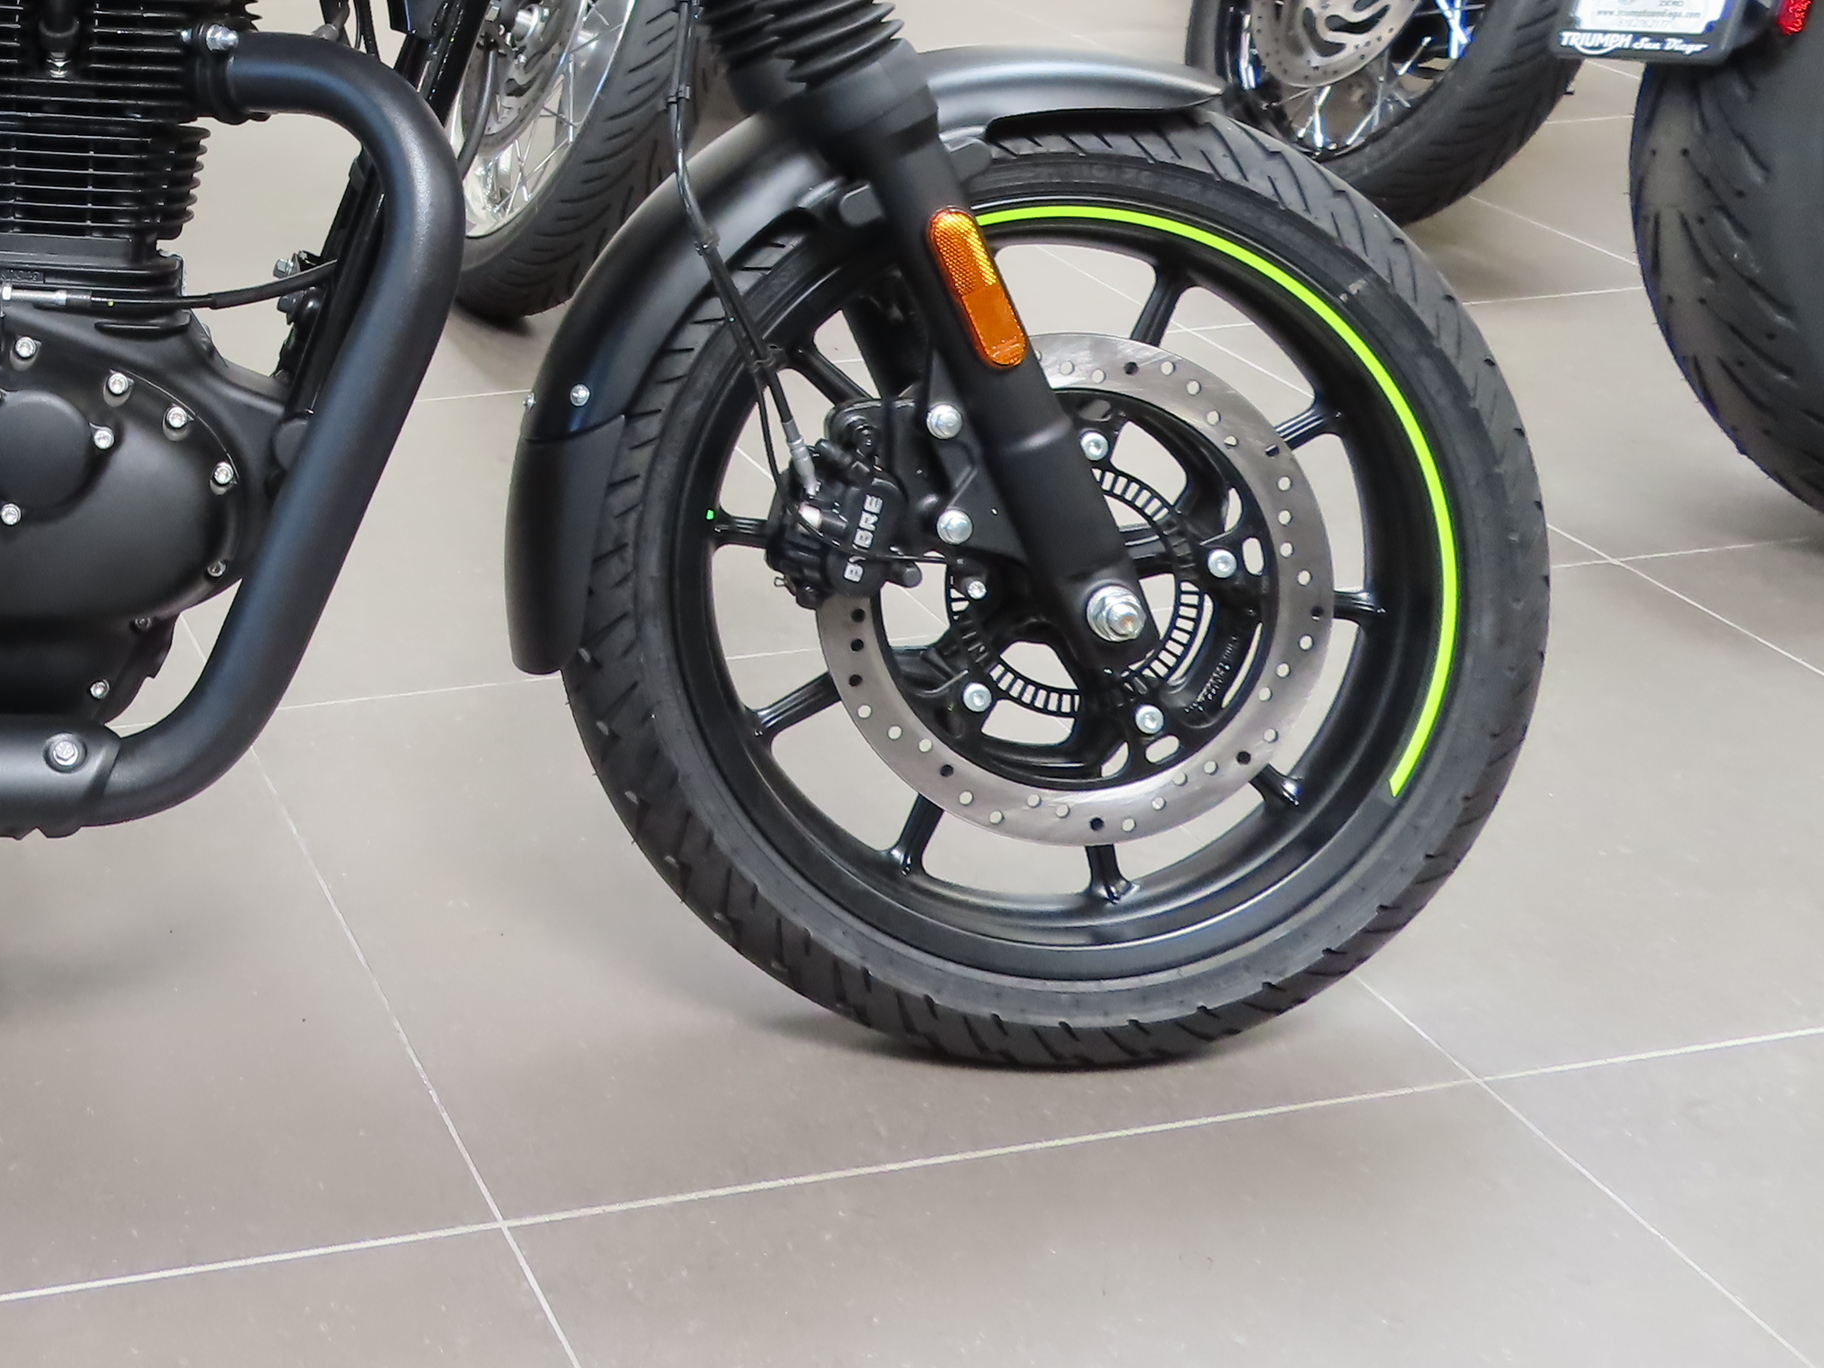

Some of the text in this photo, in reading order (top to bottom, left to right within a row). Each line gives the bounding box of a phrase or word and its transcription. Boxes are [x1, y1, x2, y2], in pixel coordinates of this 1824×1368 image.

[1560, 32, 1709, 56] TRIUMPH San Diego
